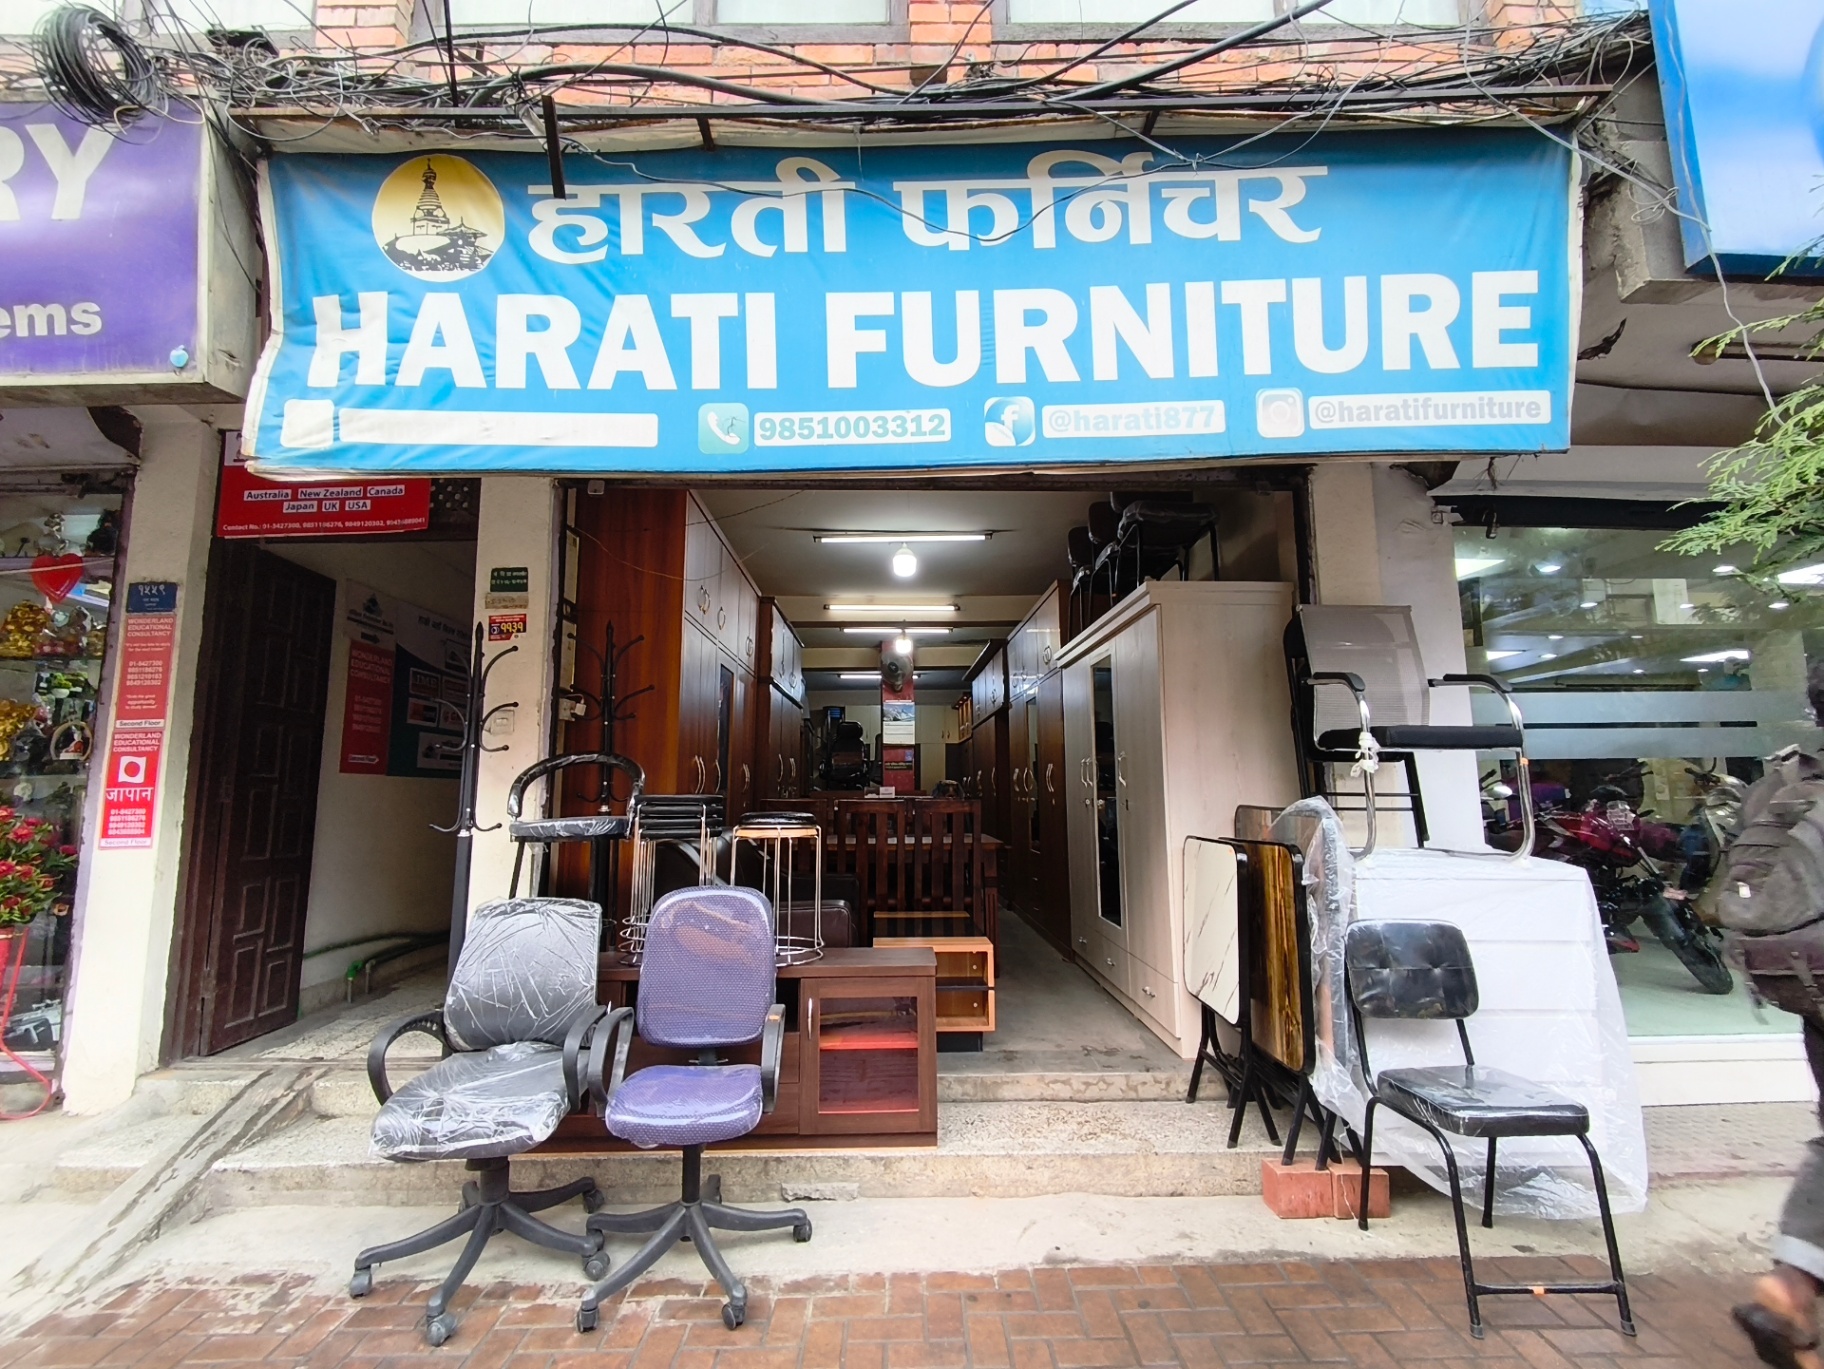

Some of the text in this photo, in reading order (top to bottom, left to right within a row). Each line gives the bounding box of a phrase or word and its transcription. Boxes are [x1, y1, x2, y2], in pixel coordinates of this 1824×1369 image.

[527, 149, 1329, 265] हारती फर्निचर
[306, 269, 1539, 390] HARATI FURNITURE
[1049, 405, 1216, 433] @harati877
[1314, 396, 1542, 424] @haratifurniture
[758, 413, 946, 441] 9851003312
[246, 486, 404, 500] Australia New Zealand Canada
[285, 500, 368, 512] Japan UK USA
[223, 523, 248, 531] Contact
[127, 617, 174, 625] WONDERLAND
[105, 787, 154, 802] जापान
